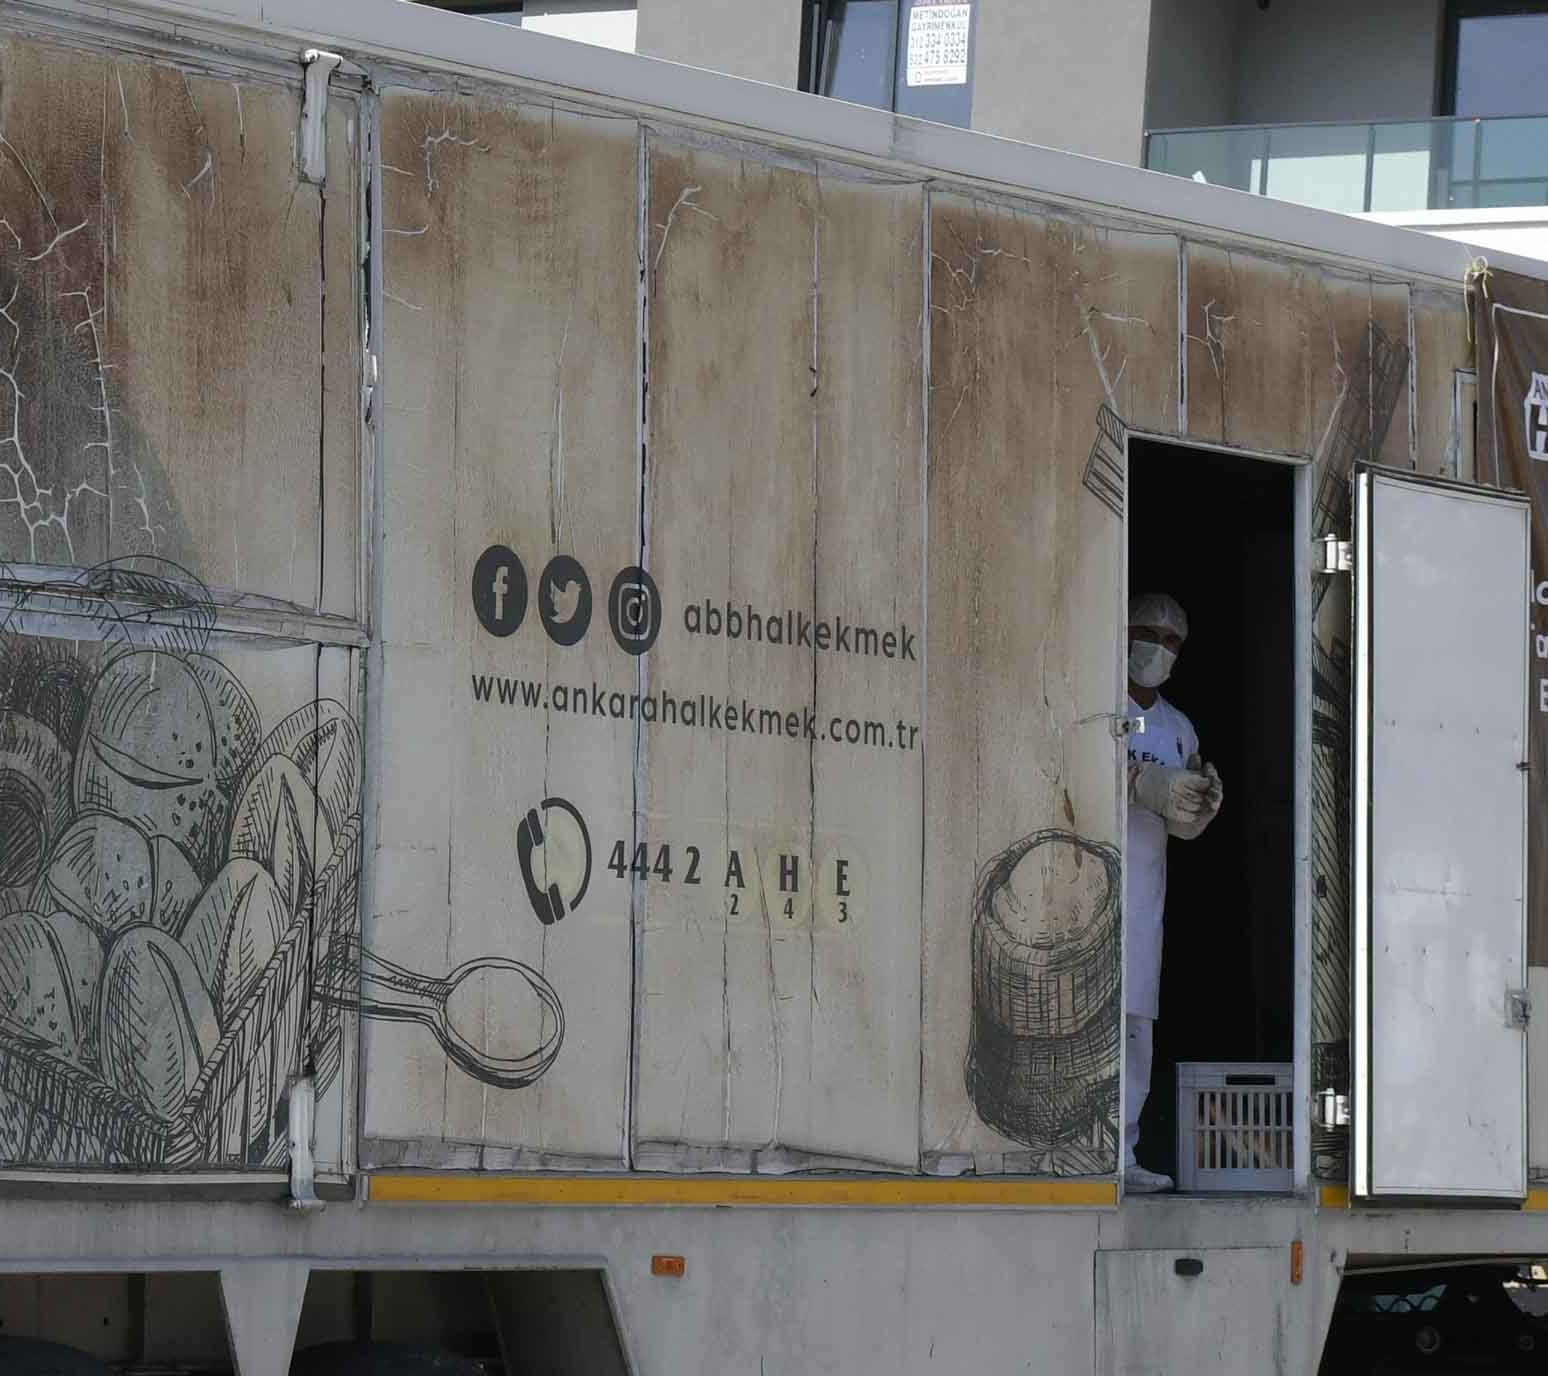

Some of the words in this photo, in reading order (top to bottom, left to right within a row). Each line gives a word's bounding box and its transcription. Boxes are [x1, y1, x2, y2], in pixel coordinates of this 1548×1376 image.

[684, 599, 918, 661] abbhalkekmek
[472, 674, 919, 751] www.ankarahalkekmek.com.tr
[724, 850, 746, 889] A
[778, 854, 799, 893] H
[836, 859, 851, 897] E
[729, 893, 740, 916] 2
[783, 897, 795, 920] 4
[838, 901, 849, 924] 3
